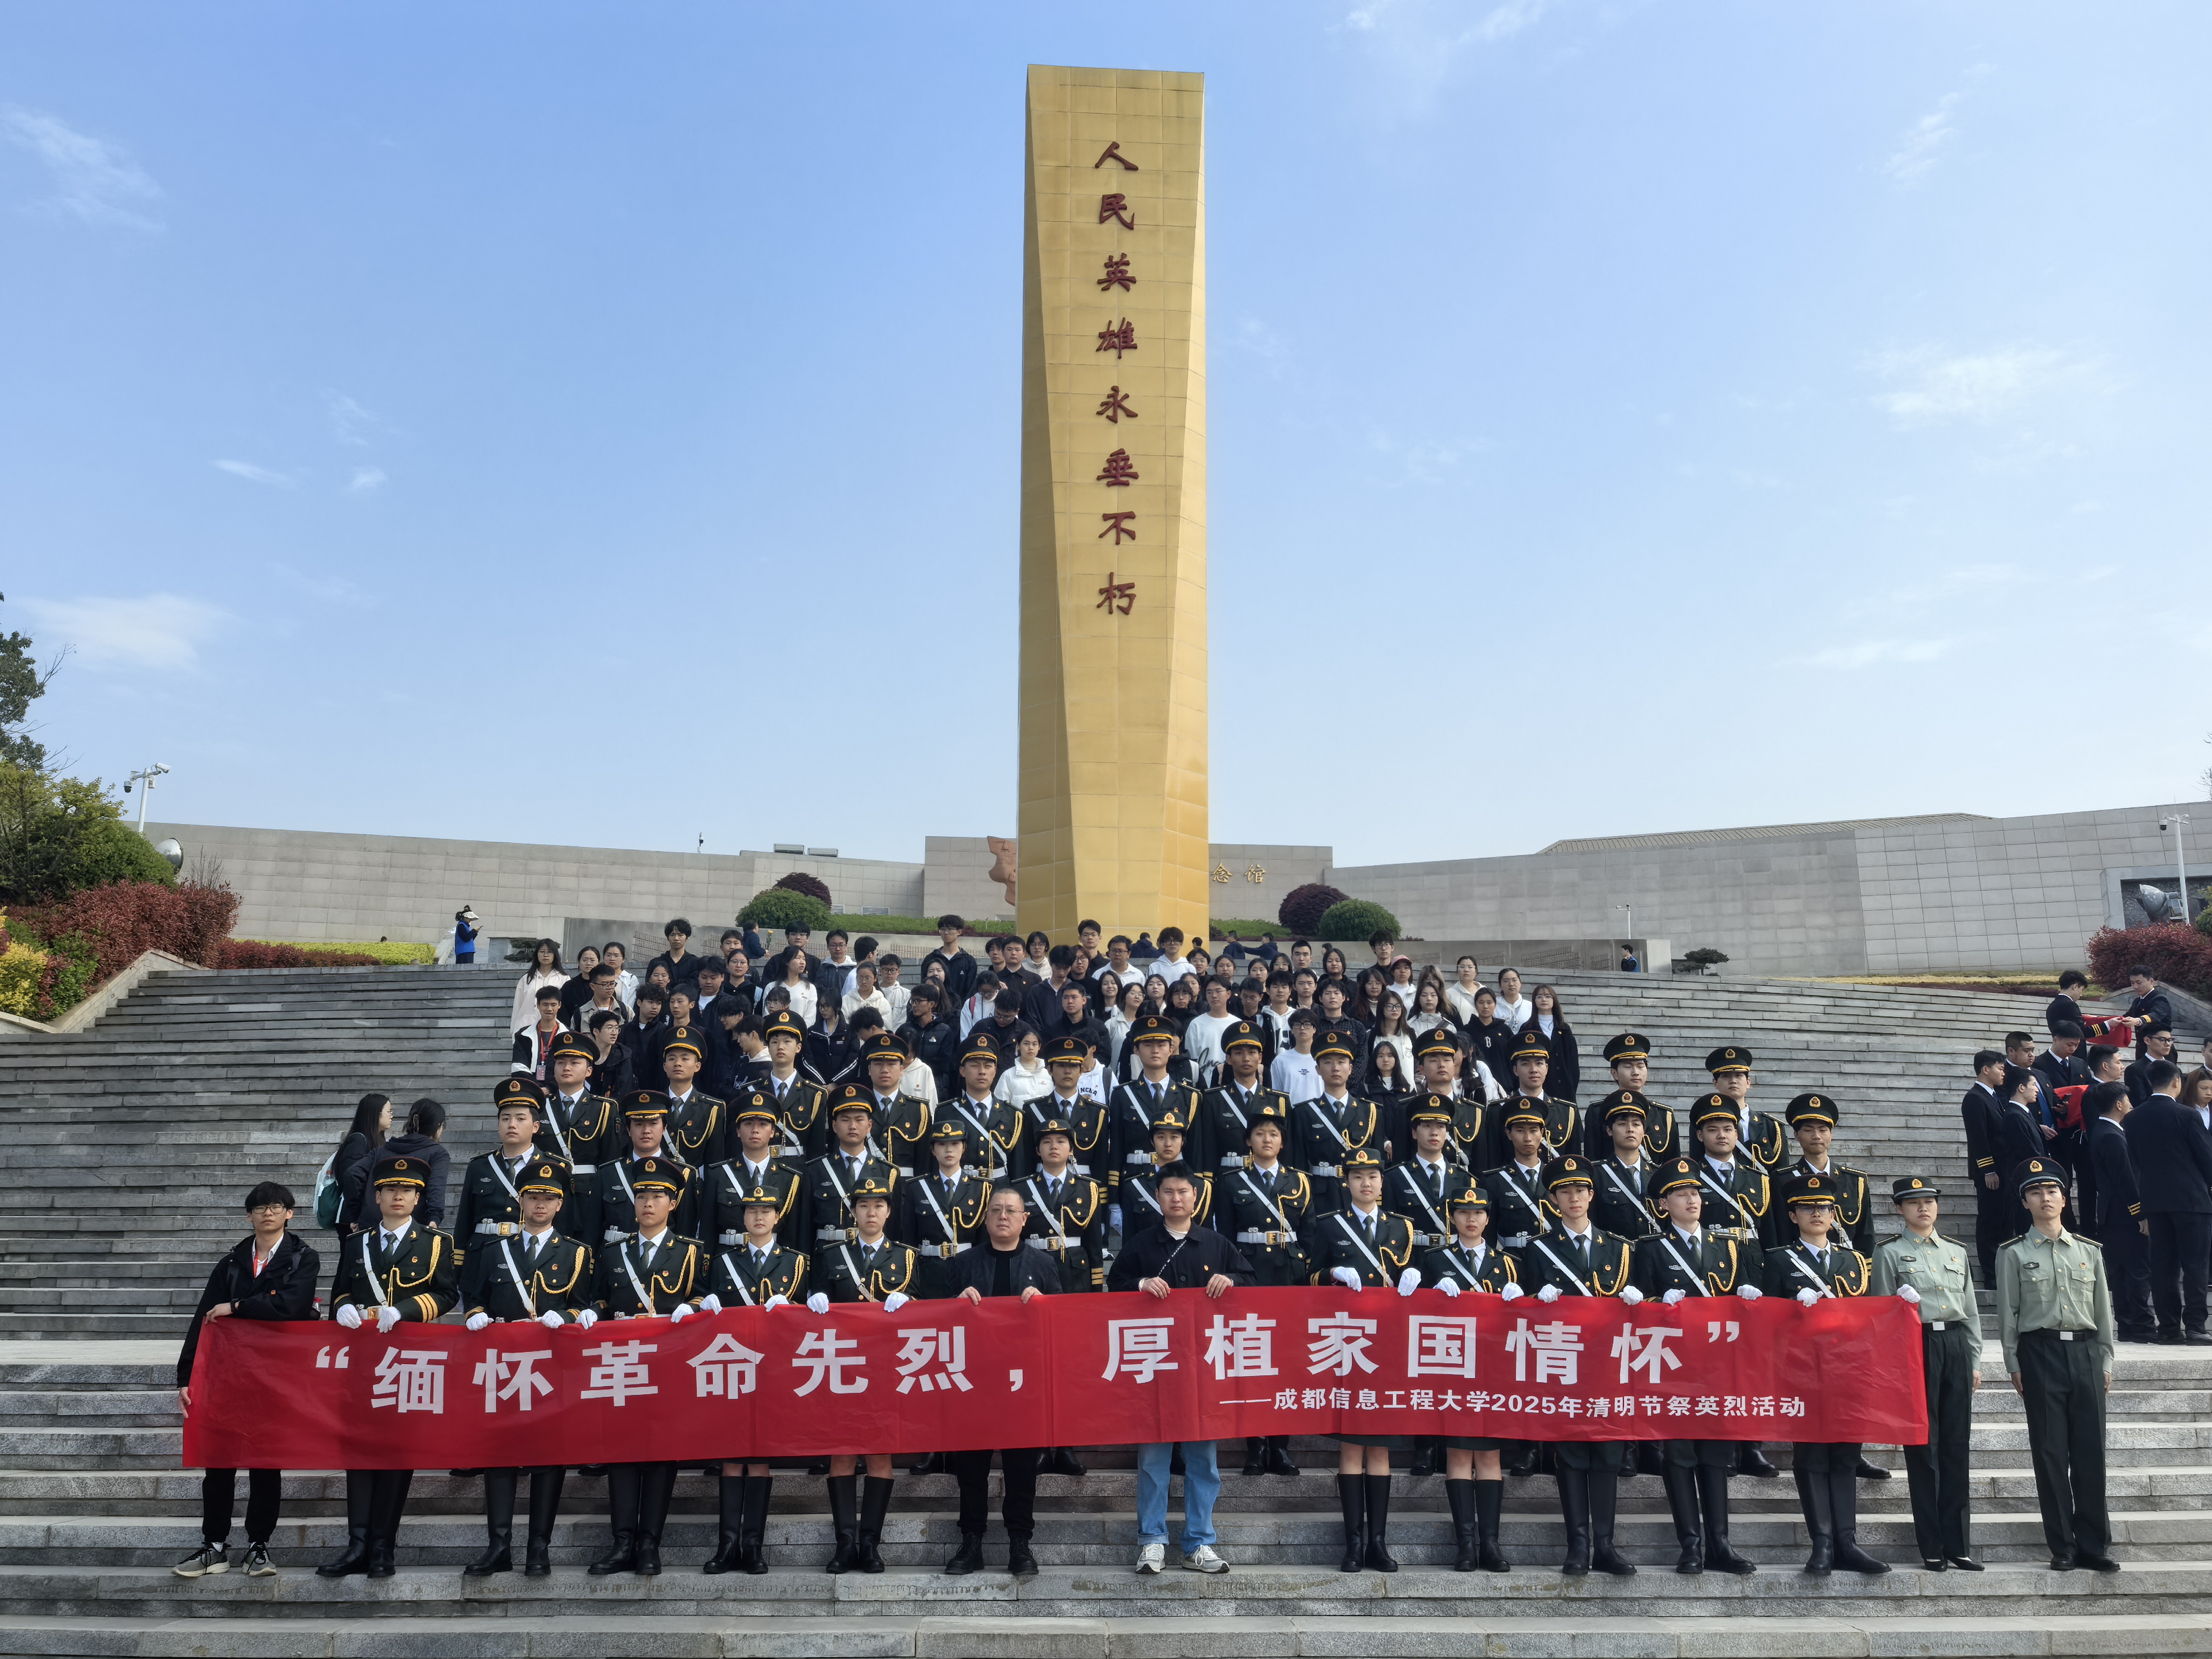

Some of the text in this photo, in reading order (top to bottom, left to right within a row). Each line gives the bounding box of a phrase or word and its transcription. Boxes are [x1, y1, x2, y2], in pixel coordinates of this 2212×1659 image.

[1095, 141, 1139, 616] 人民英雄永垂不朽
[1210, 862, 1266, 883] 念馆
